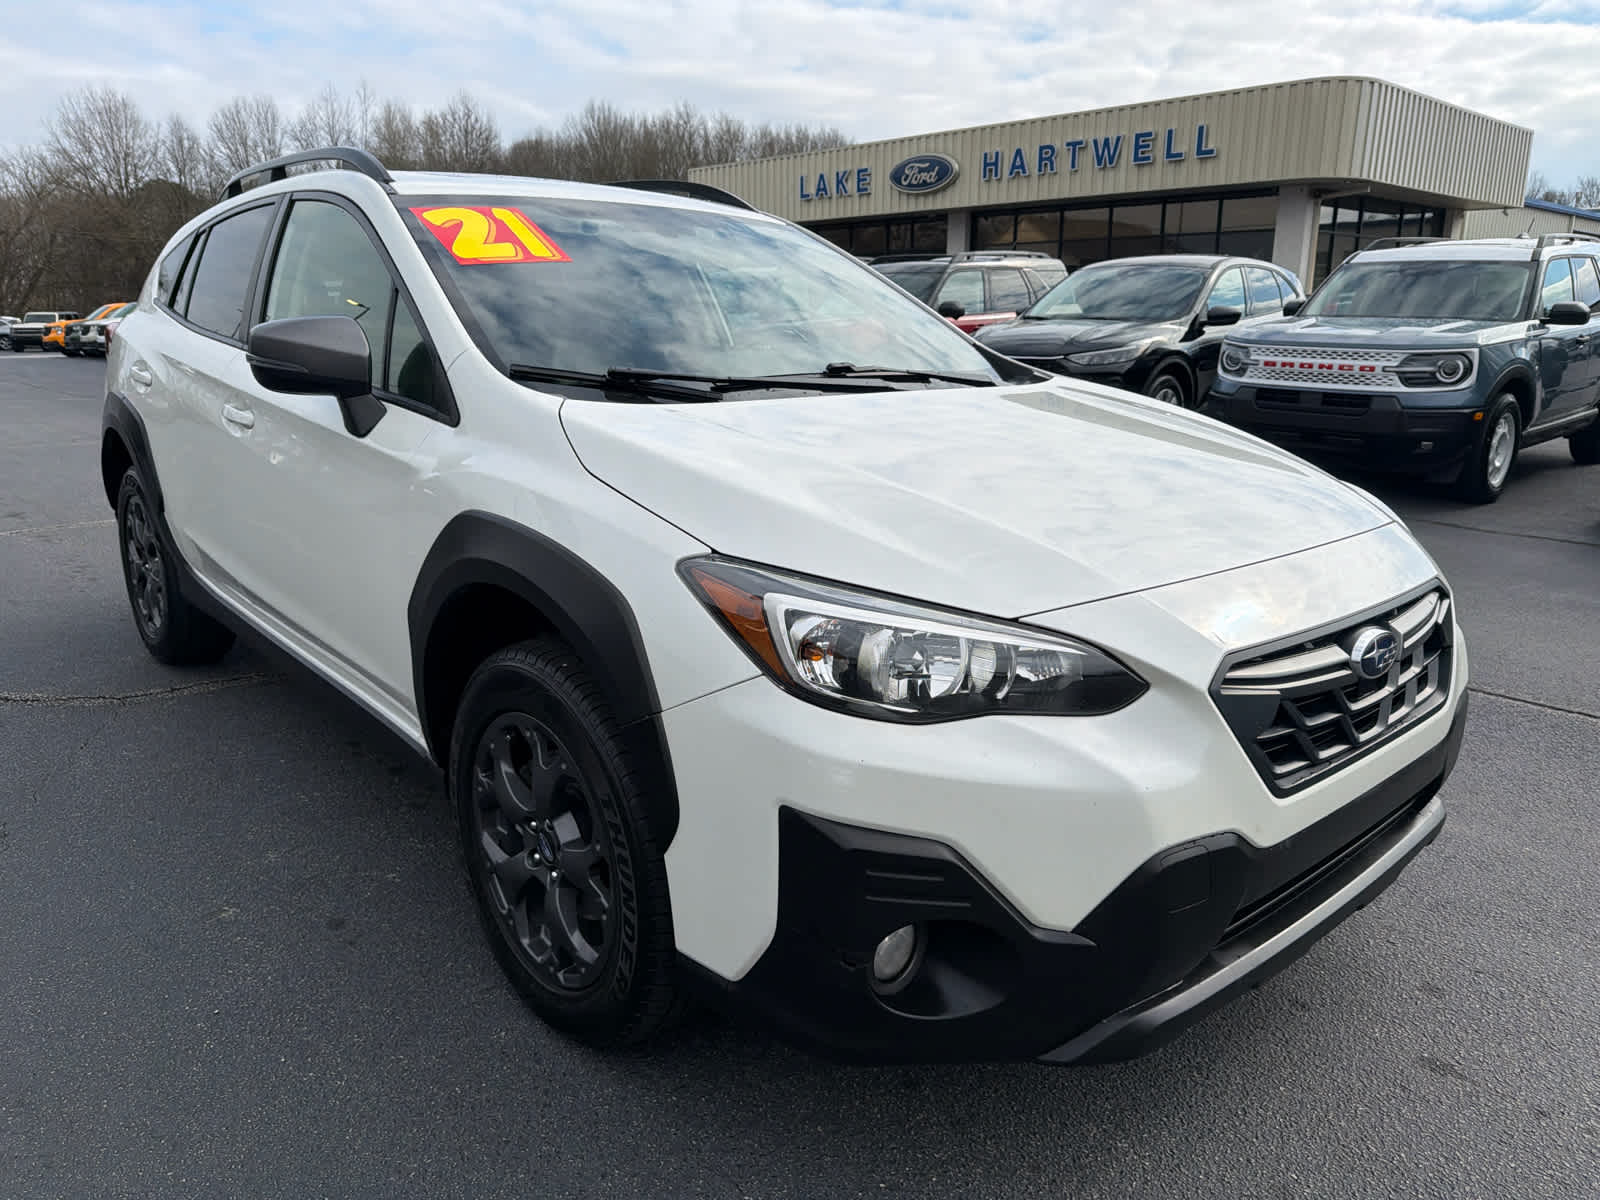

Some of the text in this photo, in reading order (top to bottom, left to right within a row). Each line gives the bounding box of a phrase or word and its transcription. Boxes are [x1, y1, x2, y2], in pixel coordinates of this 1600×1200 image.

[800, 124, 1218, 200] LAKE Ford HARTWELL
[421, 206, 562, 261] 21
[1263, 360, 1377, 373] BRONCO
